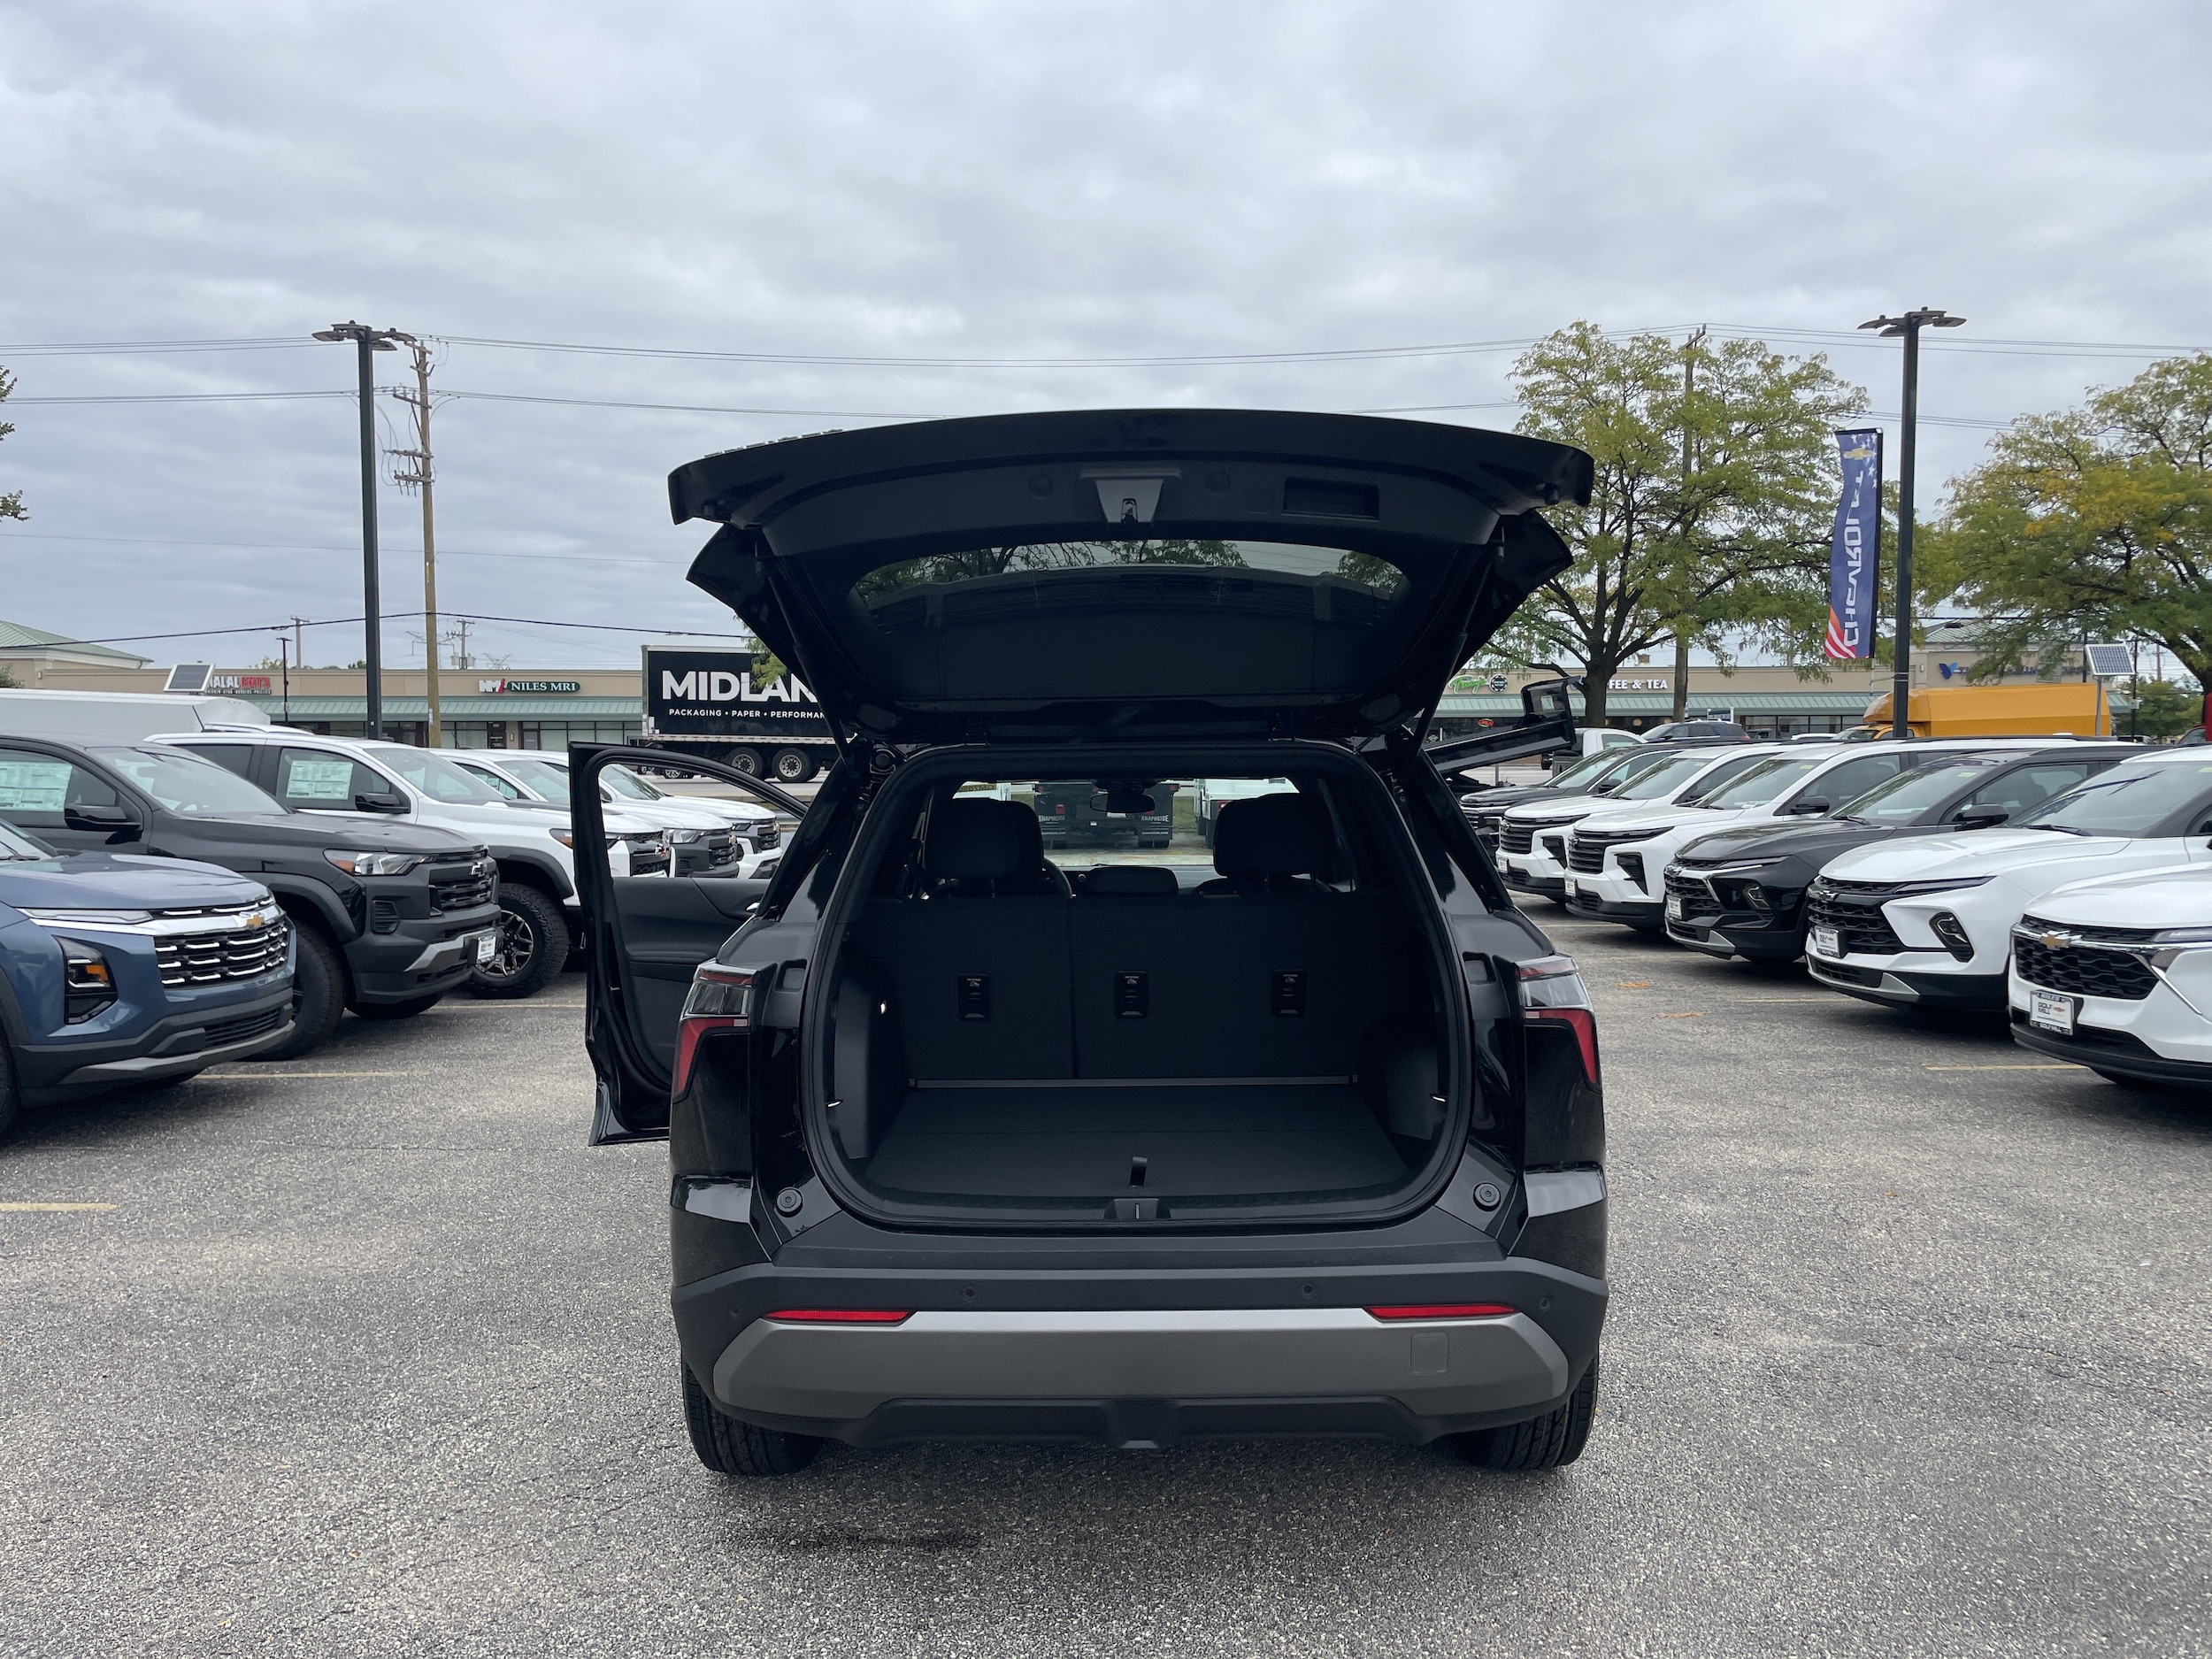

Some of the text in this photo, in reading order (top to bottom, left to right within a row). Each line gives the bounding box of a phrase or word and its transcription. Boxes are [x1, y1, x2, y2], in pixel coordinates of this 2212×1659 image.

[242, 675, 271, 688] EATS
[511, 681, 548, 691] NILES
[550, 681, 576, 691] MRI
[662, 670, 818, 703] MIDLAN
[1608, 679, 1668, 689] FEE & TEA
